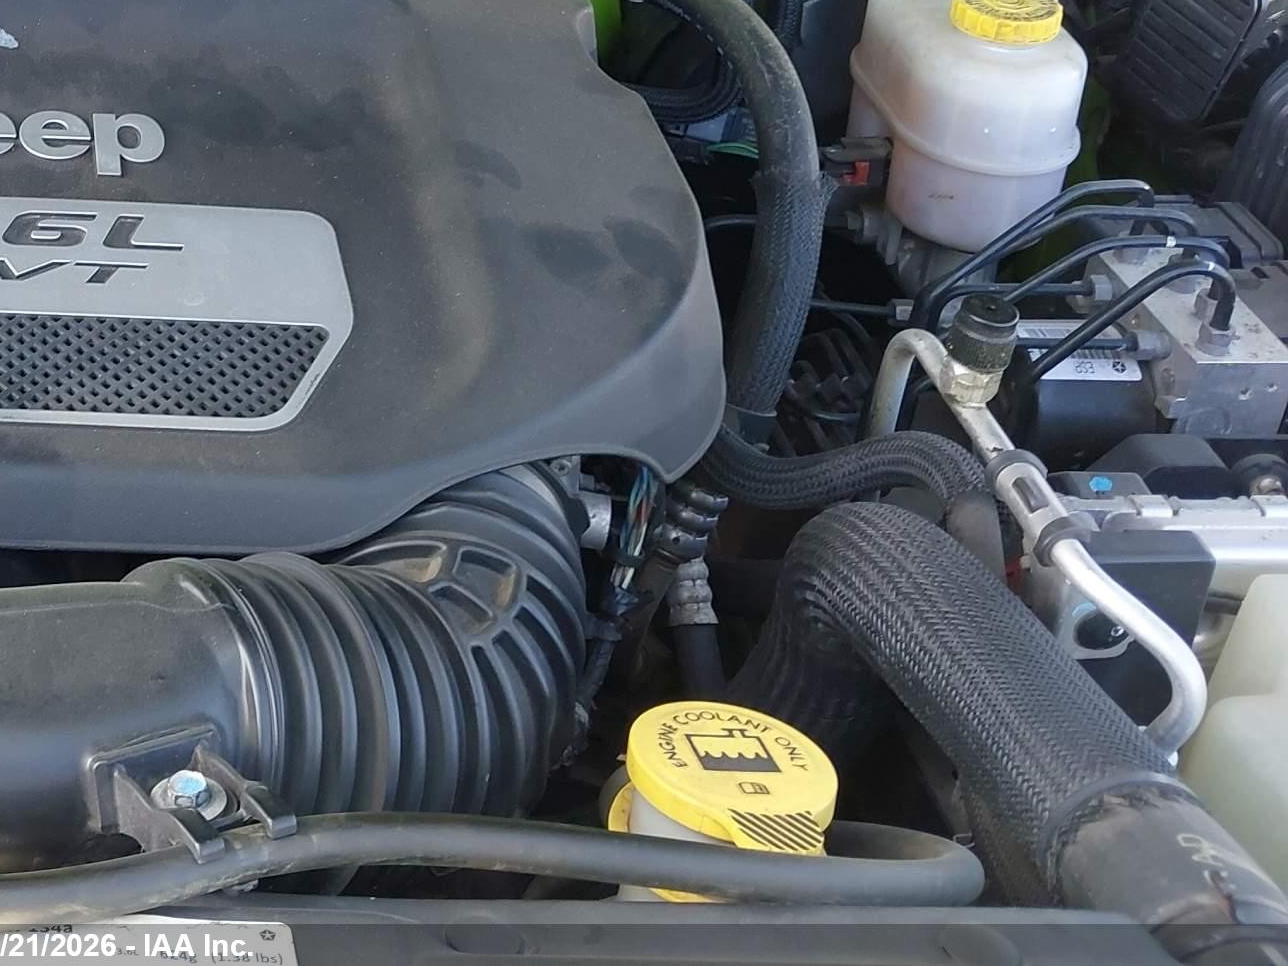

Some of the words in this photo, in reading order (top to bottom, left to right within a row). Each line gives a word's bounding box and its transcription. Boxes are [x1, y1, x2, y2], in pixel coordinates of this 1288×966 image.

[658, 722, 688, 769] ENGINE
[673, 710, 772, 734] COOLANT
[774, 736, 809, 772] ONLY
